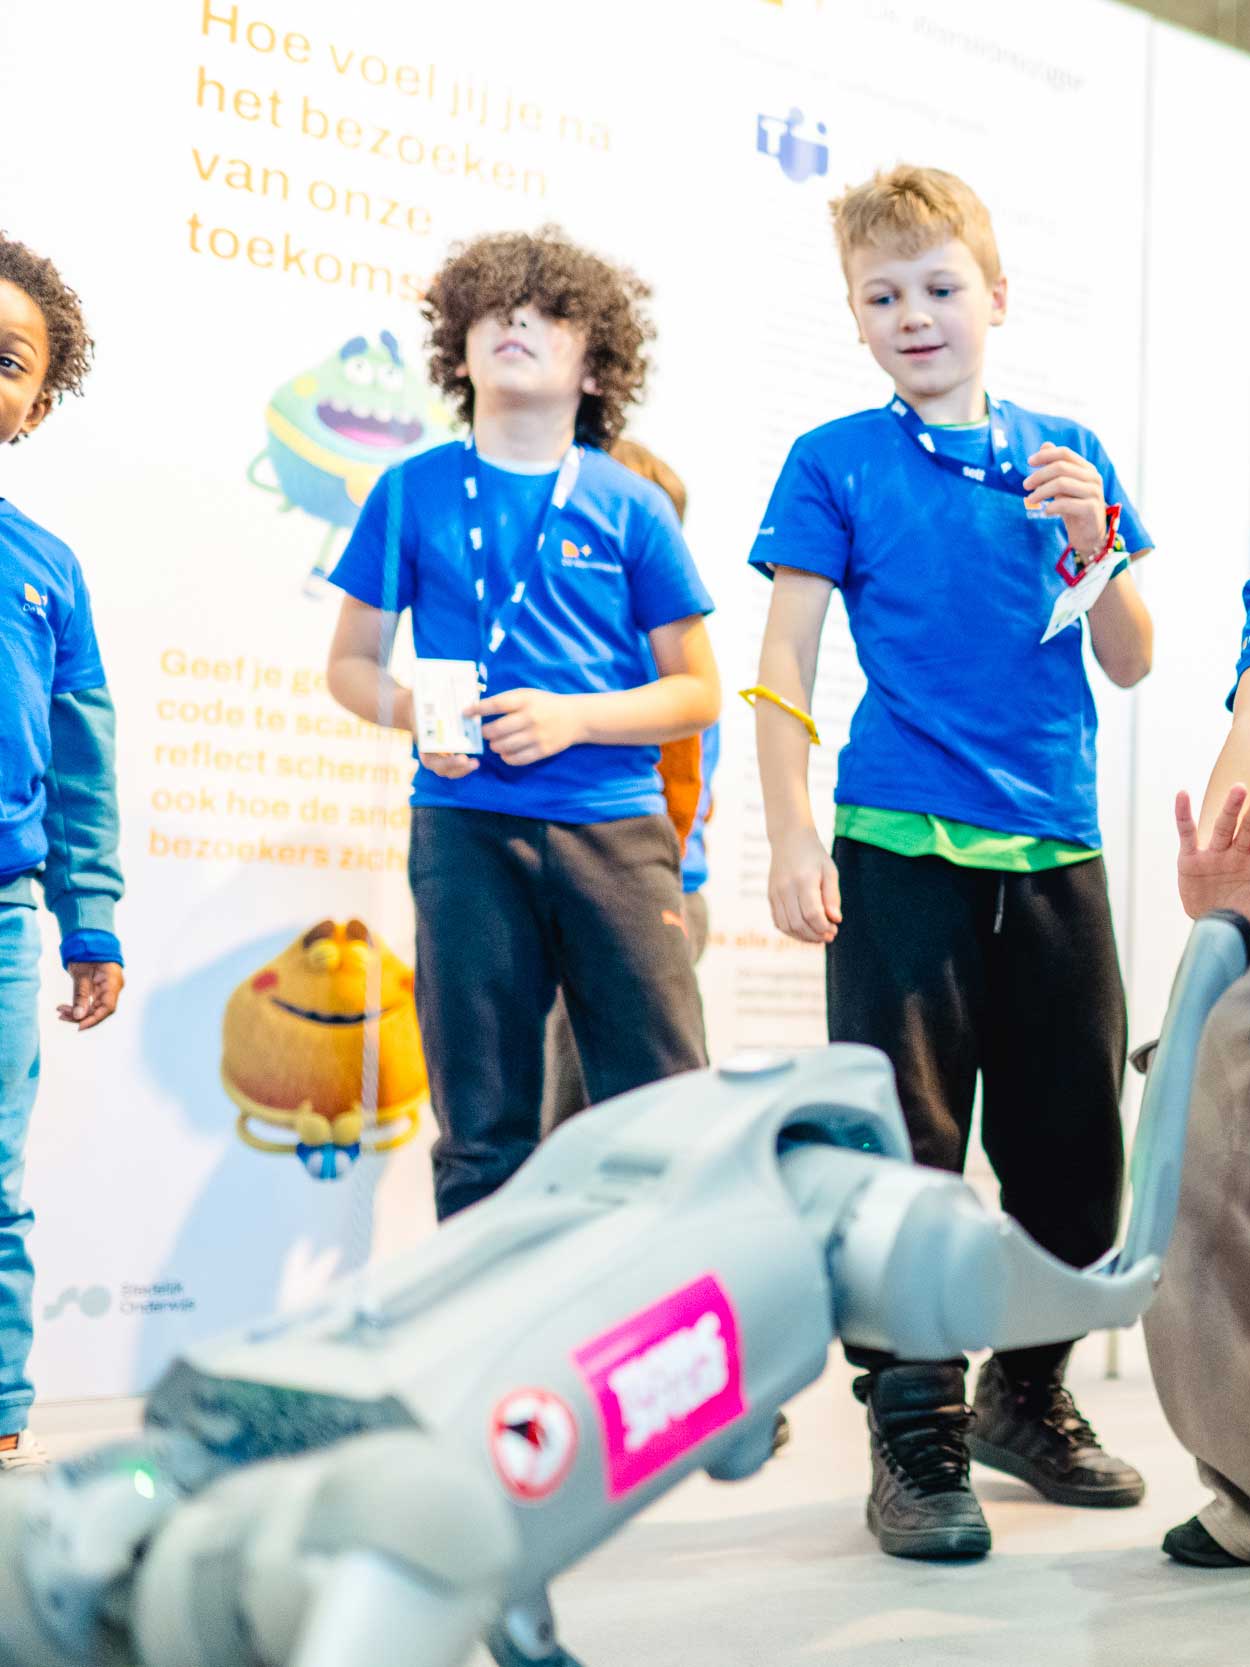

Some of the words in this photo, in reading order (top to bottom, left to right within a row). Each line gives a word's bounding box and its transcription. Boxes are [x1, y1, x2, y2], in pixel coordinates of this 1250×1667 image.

[200, 0, 313, 64] Hoe
[328, 42, 436, 101] voel
[558, 110, 613, 152] na
[195, 64, 286, 129] het
[300, 95, 549, 199] bezoeken
[191, 146, 290, 201] van
[306, 178, 433, 237] onze
[185, 211, 436, 302] toekoms
[160, 648, 245, 682] Geef
[250, 657, 283, 694] je
[156, 693, 245, 728] code
[254, 704, 287, 733] te
[153, 740, 267, 776] reflect
[276, 752, 401, 784] scherm
[151, 785, 216, 815] ook
[226, 787, 291, 821] hoe
[299, 794, 341, 825] de
[348, 802, 410, 831] and
[149, 825, 332, 869] bezoekers
